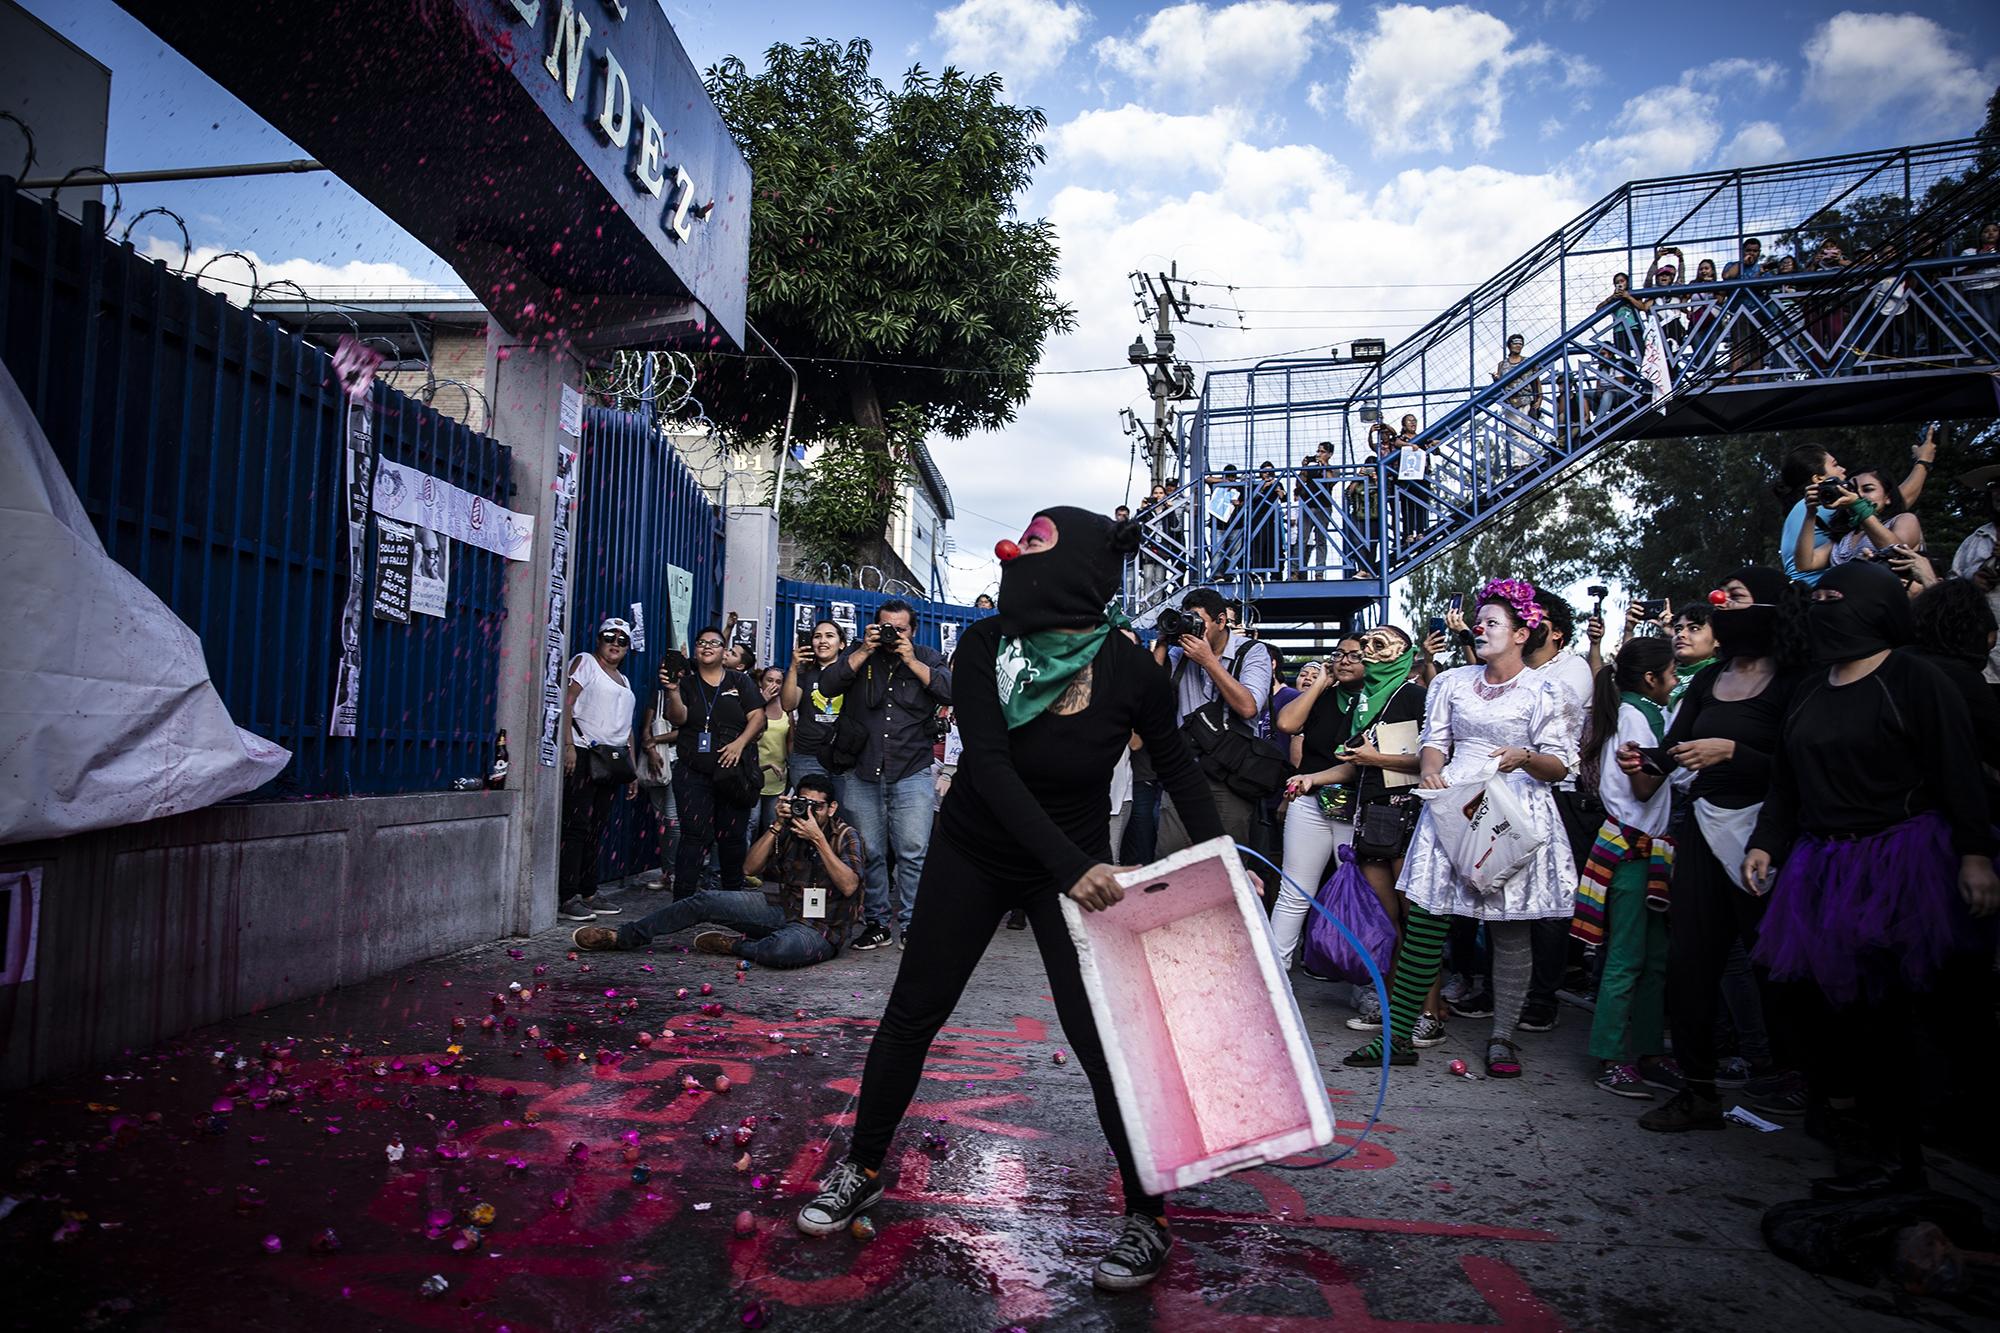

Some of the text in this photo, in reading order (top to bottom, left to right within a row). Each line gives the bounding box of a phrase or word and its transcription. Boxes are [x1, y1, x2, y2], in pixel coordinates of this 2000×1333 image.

[733, 454, 763, 471] B-1
[379, 543, 409, 554] SOLO POR
[379, 556, 408, 566] UN FALLO
[384, 568, 394, 578] ES
[394, 572, 407, 585] POR
[379, 591, 400, 606] ABUSO
[400, 600, 405, 608] E
